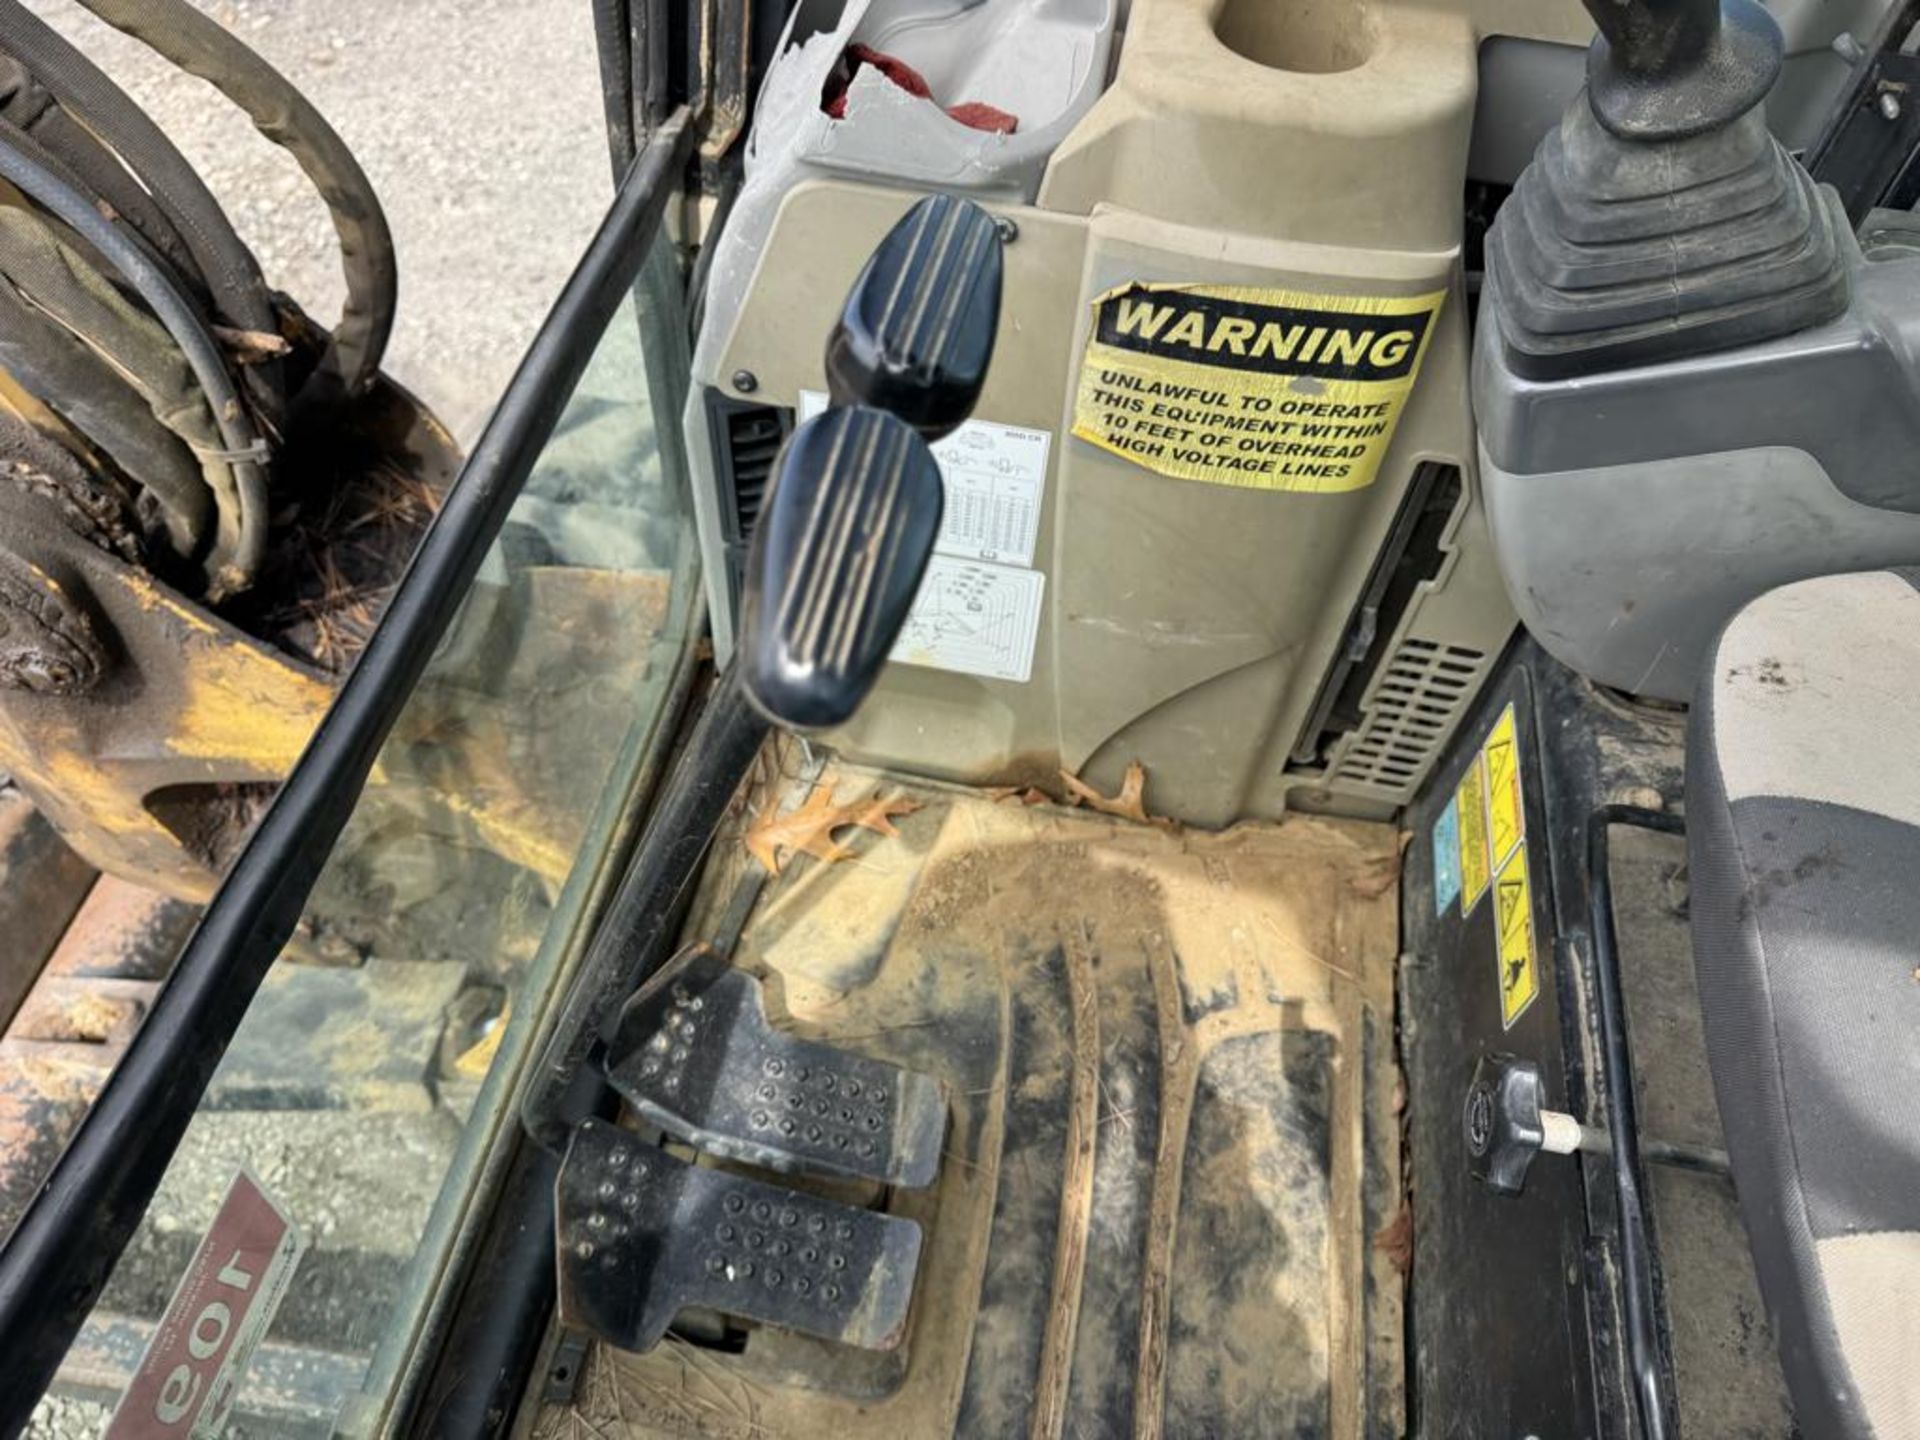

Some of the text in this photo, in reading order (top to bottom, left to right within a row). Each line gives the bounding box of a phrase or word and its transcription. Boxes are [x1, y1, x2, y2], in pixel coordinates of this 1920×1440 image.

[1115, 299, 1415, 368] WARNING
[1092, 388, 1388, 439] THIS EQUIPMENT WITHIN
[1100, 369, 1391, 419] UNLAWFUL TO OPERATE
[1103, 412, 1367, 459] 10 FEET OF OVERHEAD
[1106, 433, 1352, 478] HIGH VOLTAGE LINES
